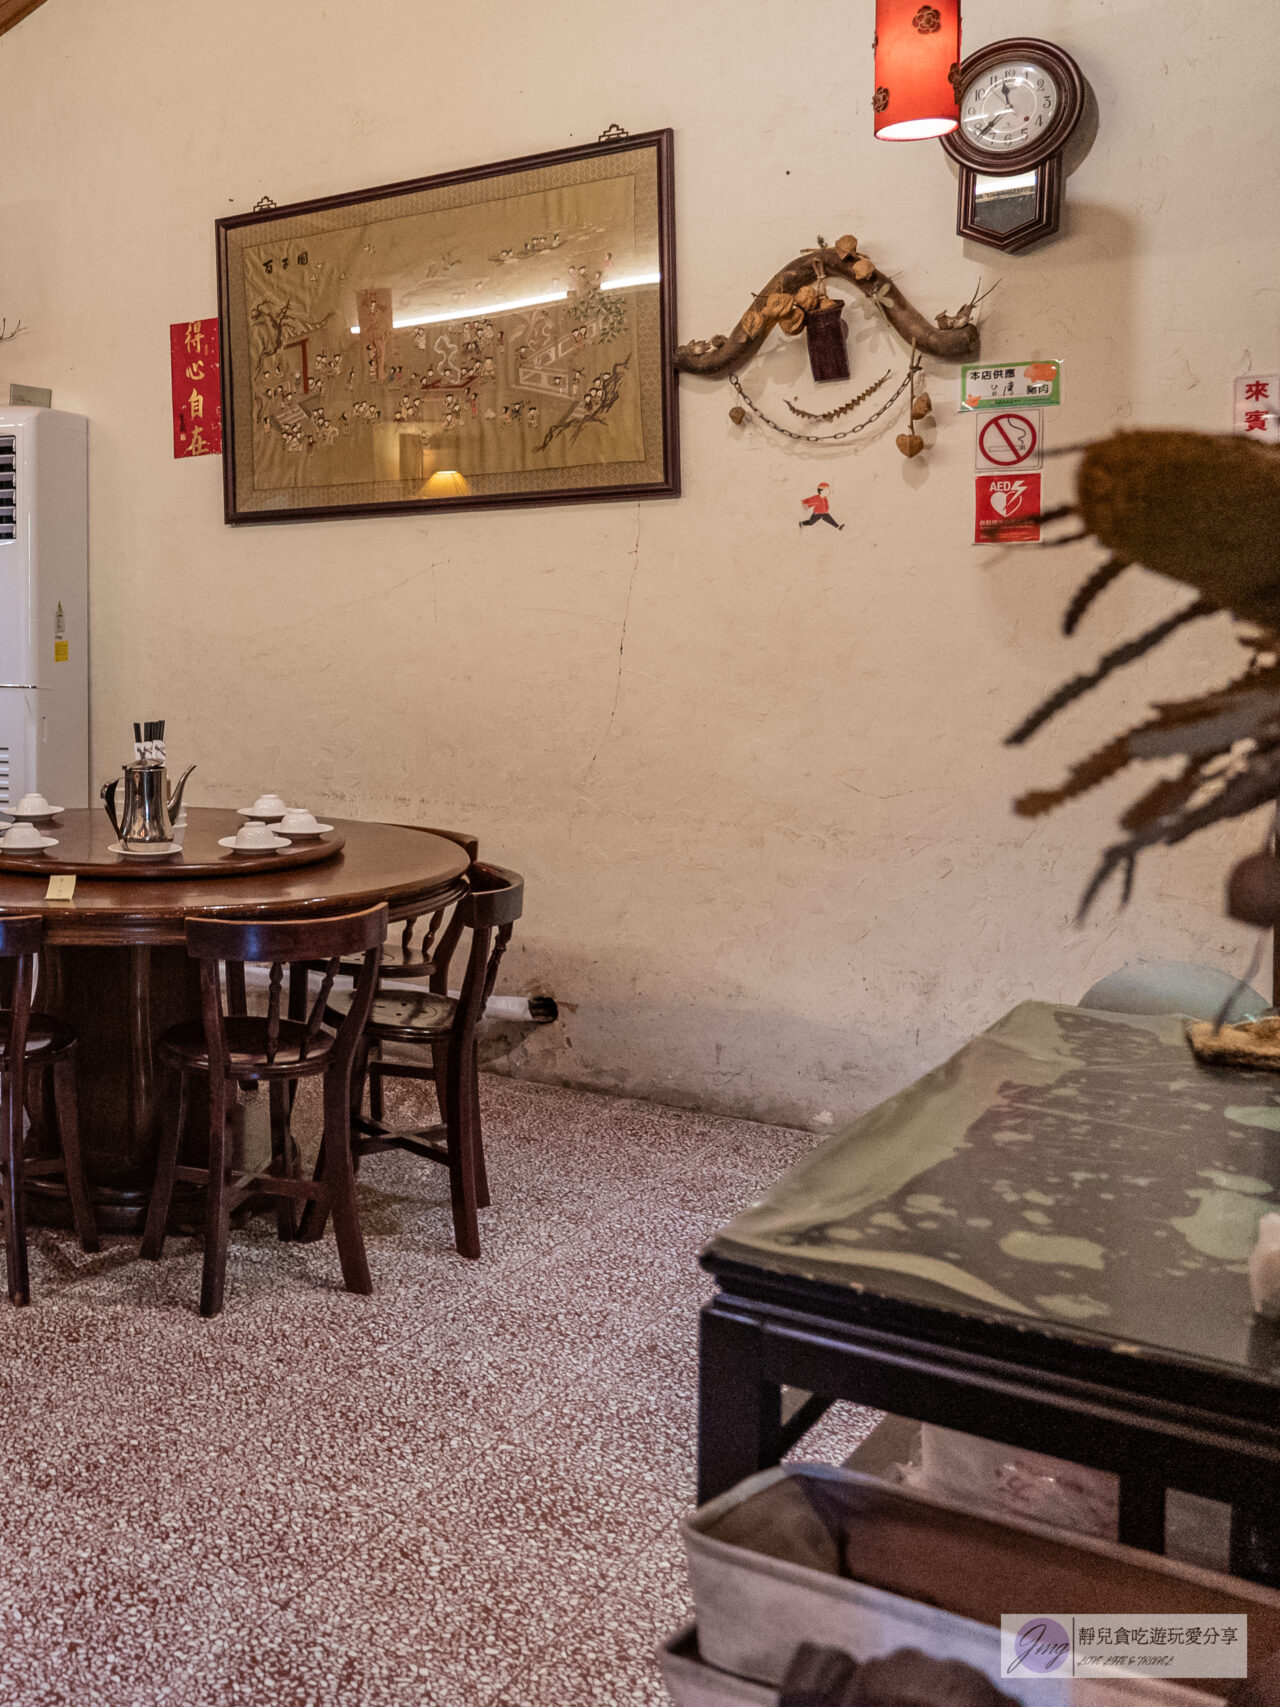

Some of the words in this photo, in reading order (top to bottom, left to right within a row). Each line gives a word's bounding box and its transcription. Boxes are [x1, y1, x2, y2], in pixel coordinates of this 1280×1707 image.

[990, 75, 998, 88] 11
[1036, 79, 1045, 92] 2
[974, 88, 986, 102] 10
[1042, 95, 1051, 109] 3
[1034, 114, 1044, 127] 4
[988, 132, 998, 145] 7
[1003, 133, 1013, 147] 6
[1021, 127, 1029, 140] 5
[970, 368, 1015, 381] 本店供應
[184, 320, 210, 456] 得心自在
[1026, 383, 1049, 395] 豬肉
[1245, 380, 1269, 432] 來賓
[989, 481, 1011, 491] AED
